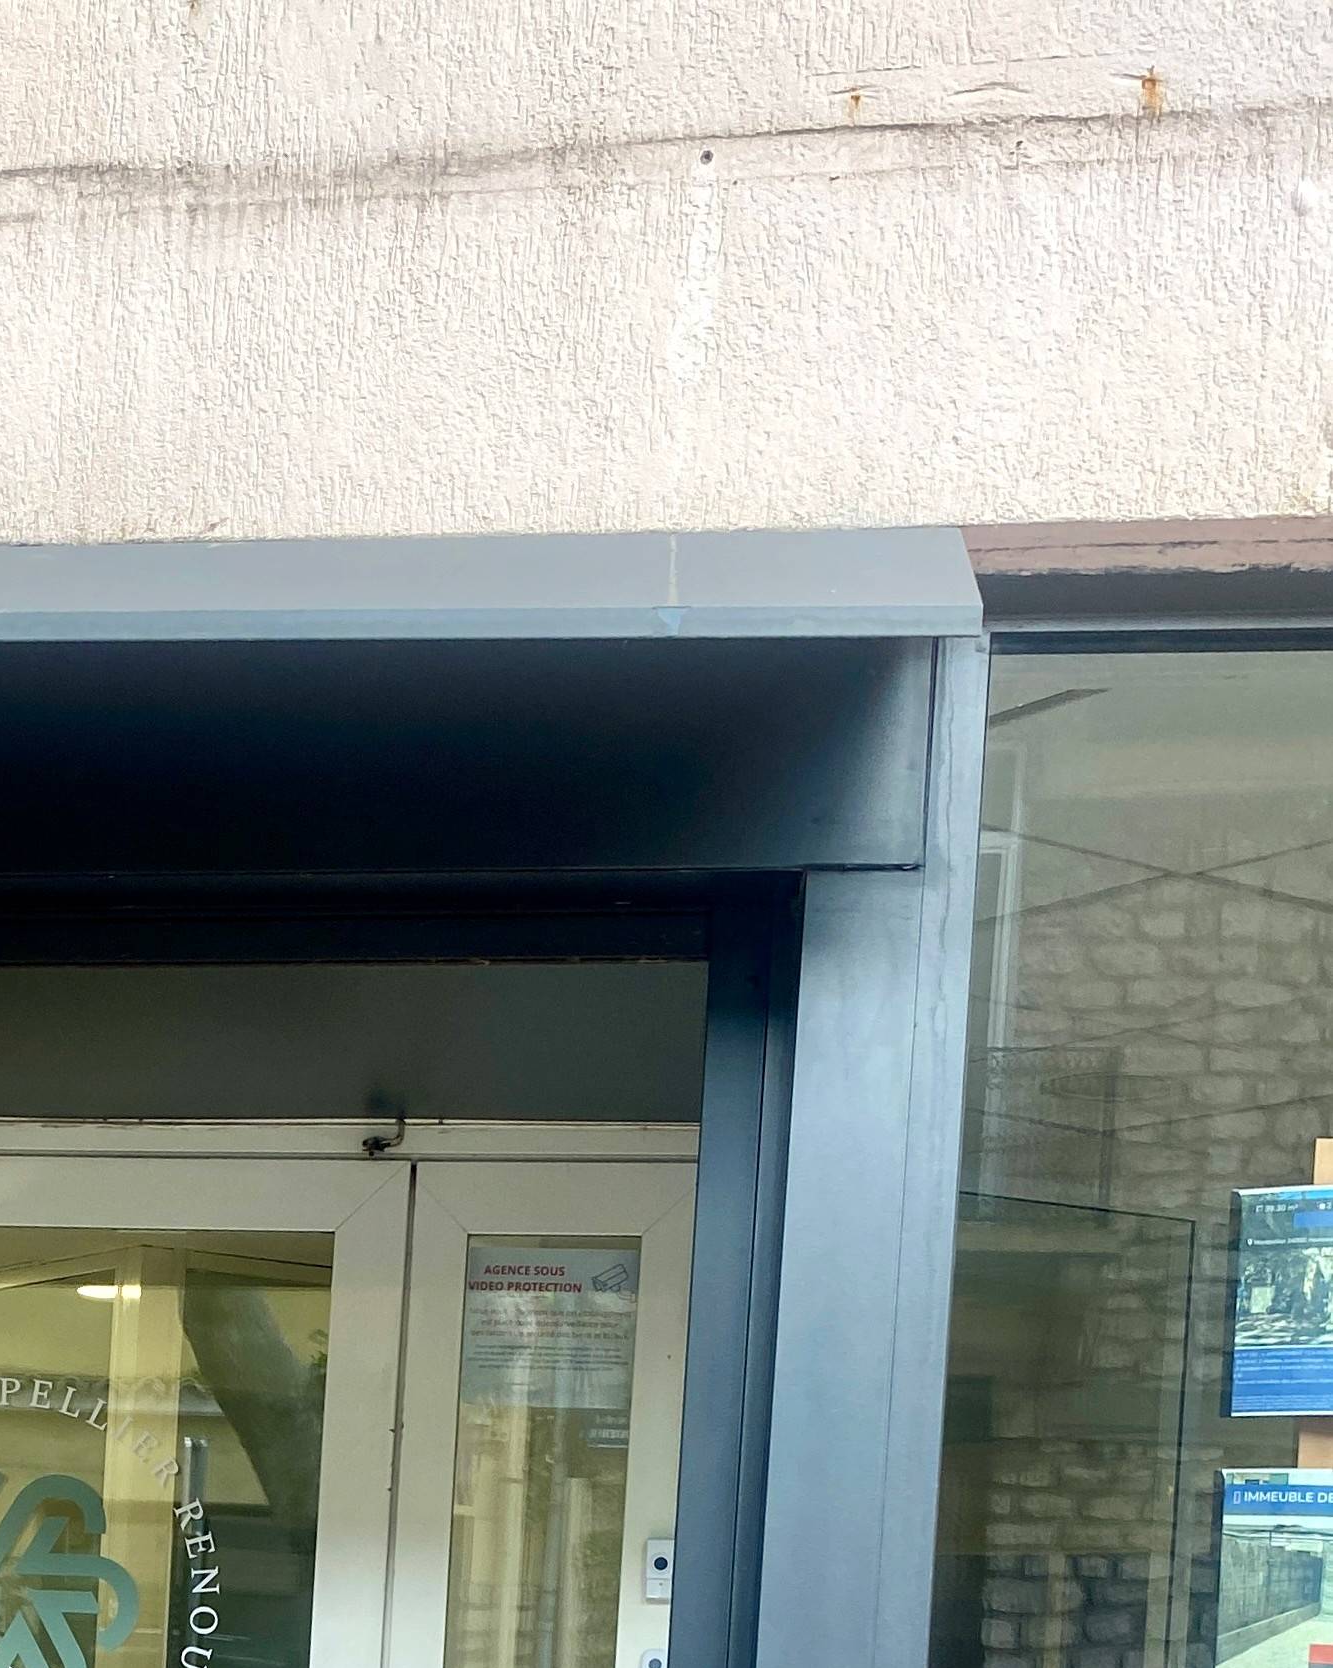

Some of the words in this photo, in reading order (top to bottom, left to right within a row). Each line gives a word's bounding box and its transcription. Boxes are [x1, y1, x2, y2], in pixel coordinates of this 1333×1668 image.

[484, 1265, 531, 1275] AGENCE
[533, 1265, 565, 1276] SOUS
[468, 1281, 504, 1291] VIDEO
[507, 1281, 582, 1293] PROTECTION
[1244, 1491, 1314, 1503] IMMEUBLE
